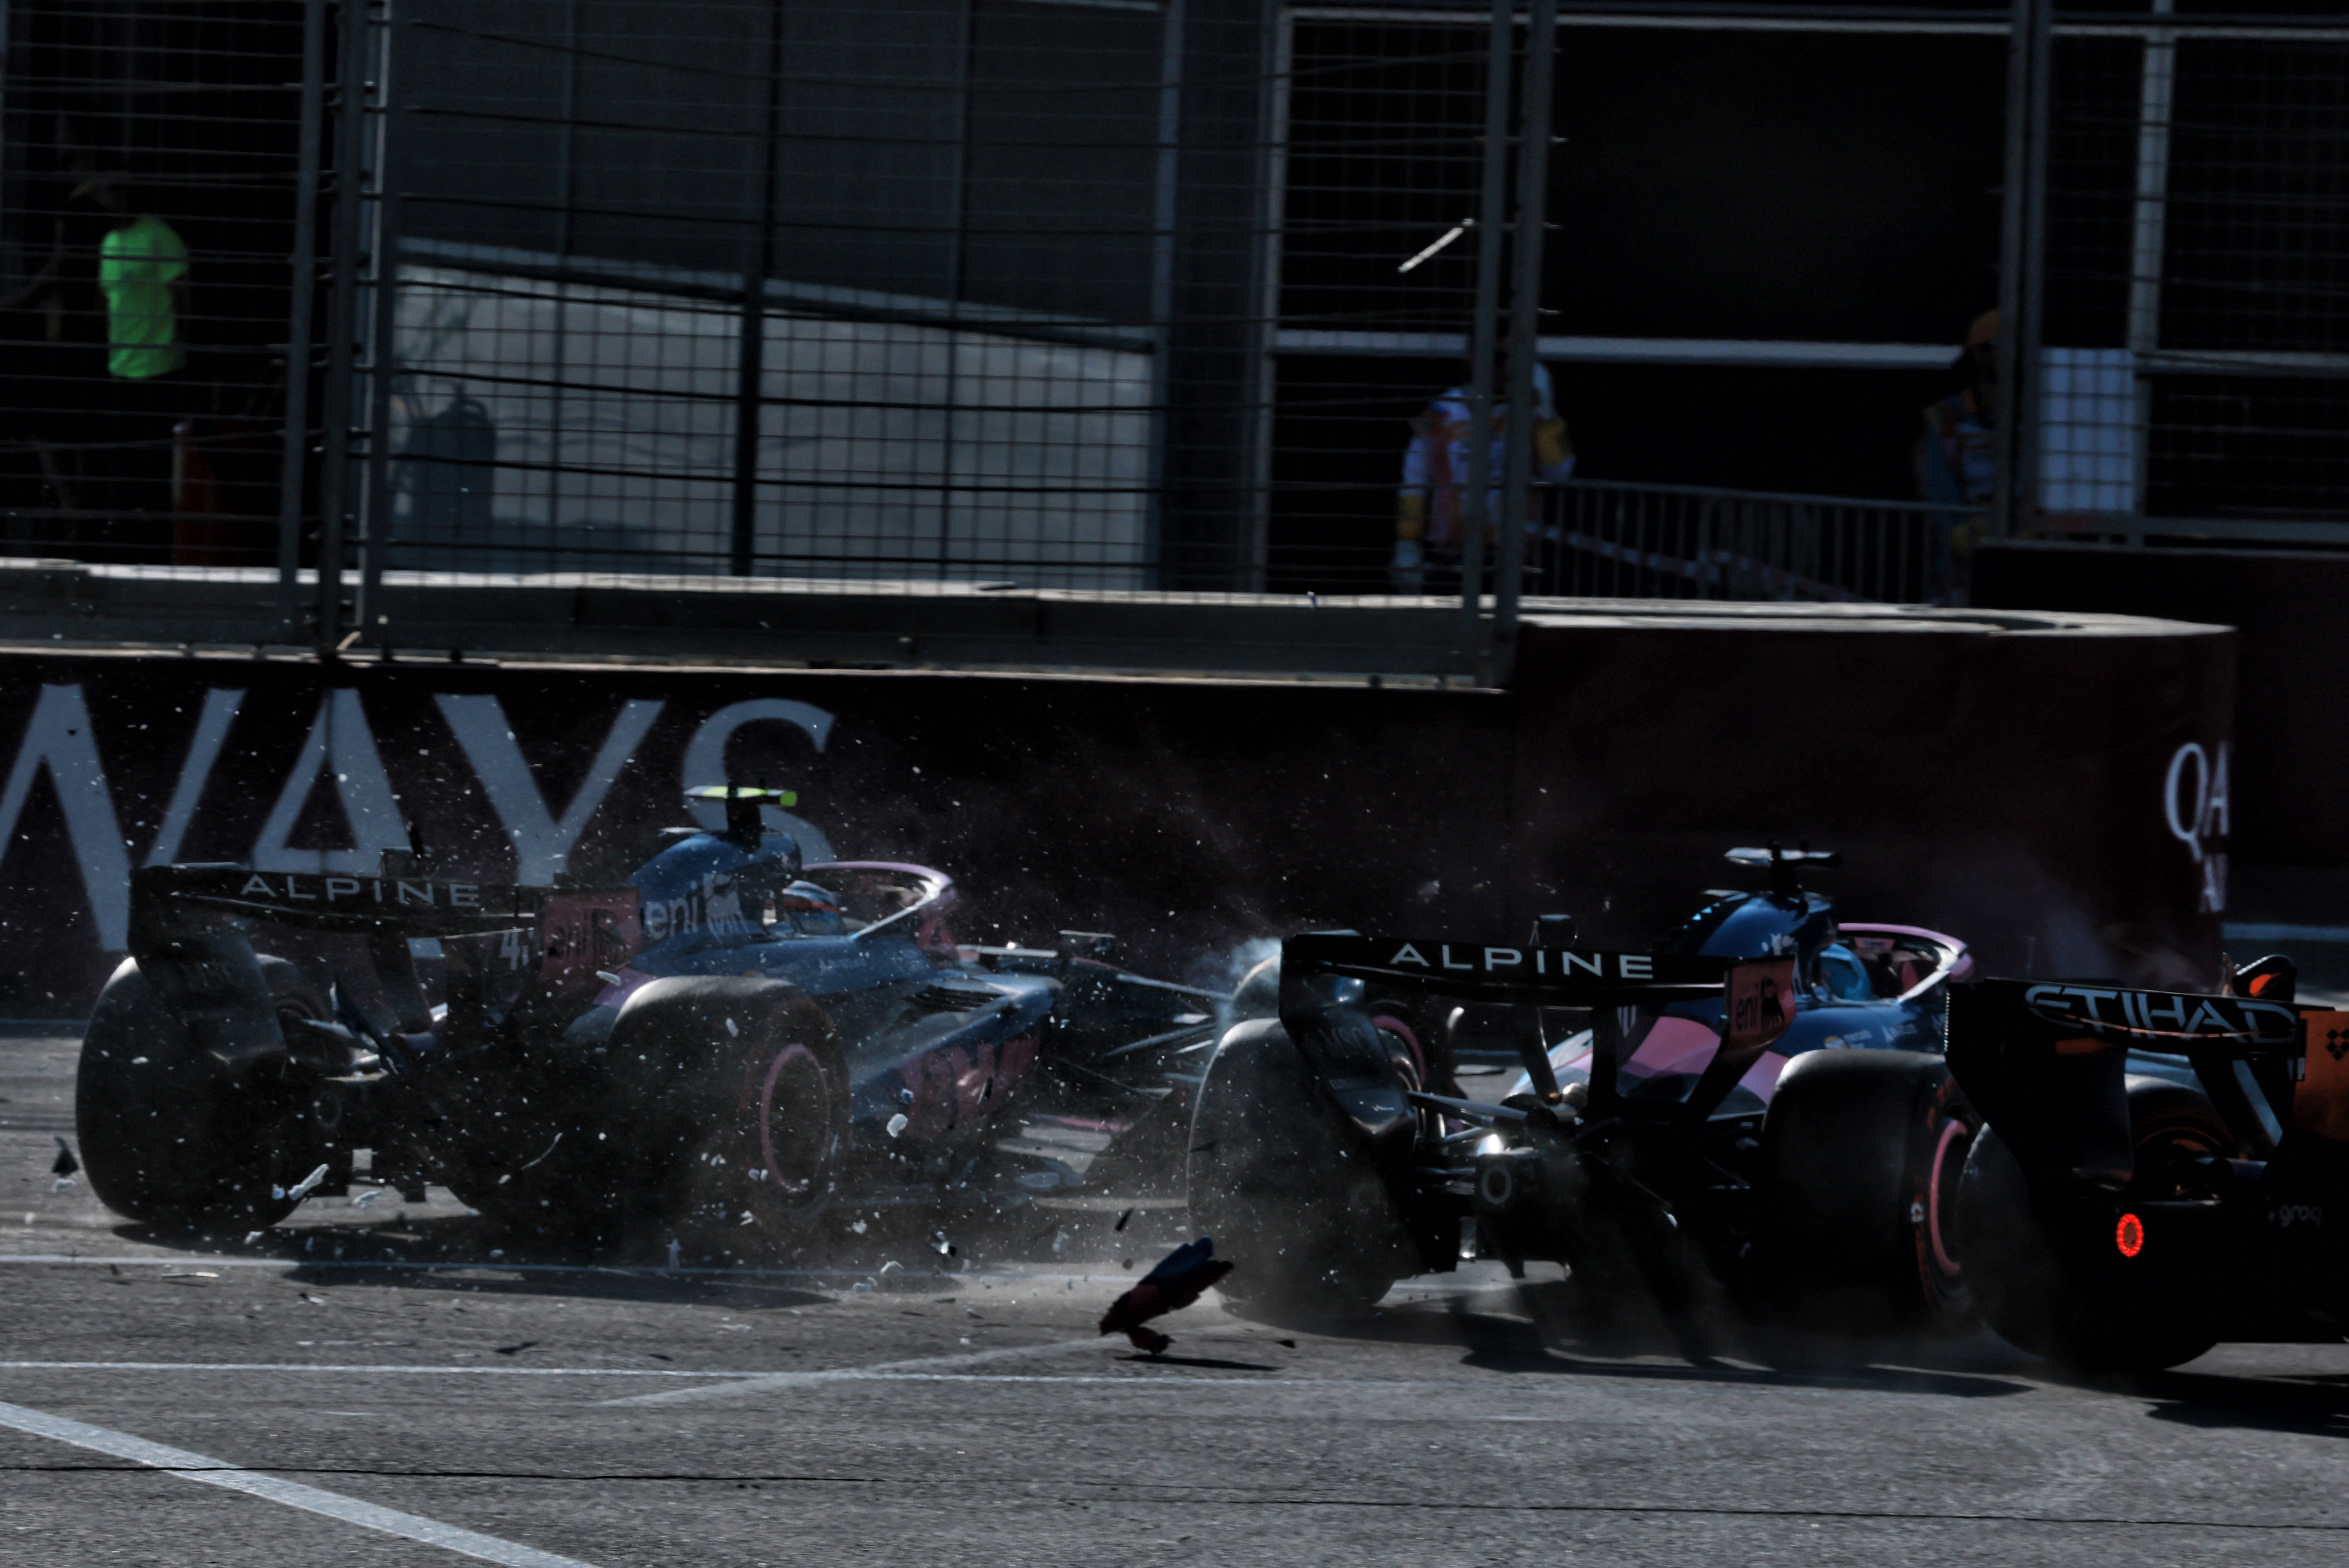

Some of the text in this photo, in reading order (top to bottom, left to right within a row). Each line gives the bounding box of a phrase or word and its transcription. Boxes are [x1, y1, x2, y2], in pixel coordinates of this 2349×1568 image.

[241, 873, 481, 908] ALPINE
[644, 880, 699, 941] eni
[1389, 942, 1654, 980] ALPINE
[1736, 981, 1759, 1032] eni
[2024, 984, 2297, 1044] ETIHAD
[2278, 1204, 2322, 1228] groq
